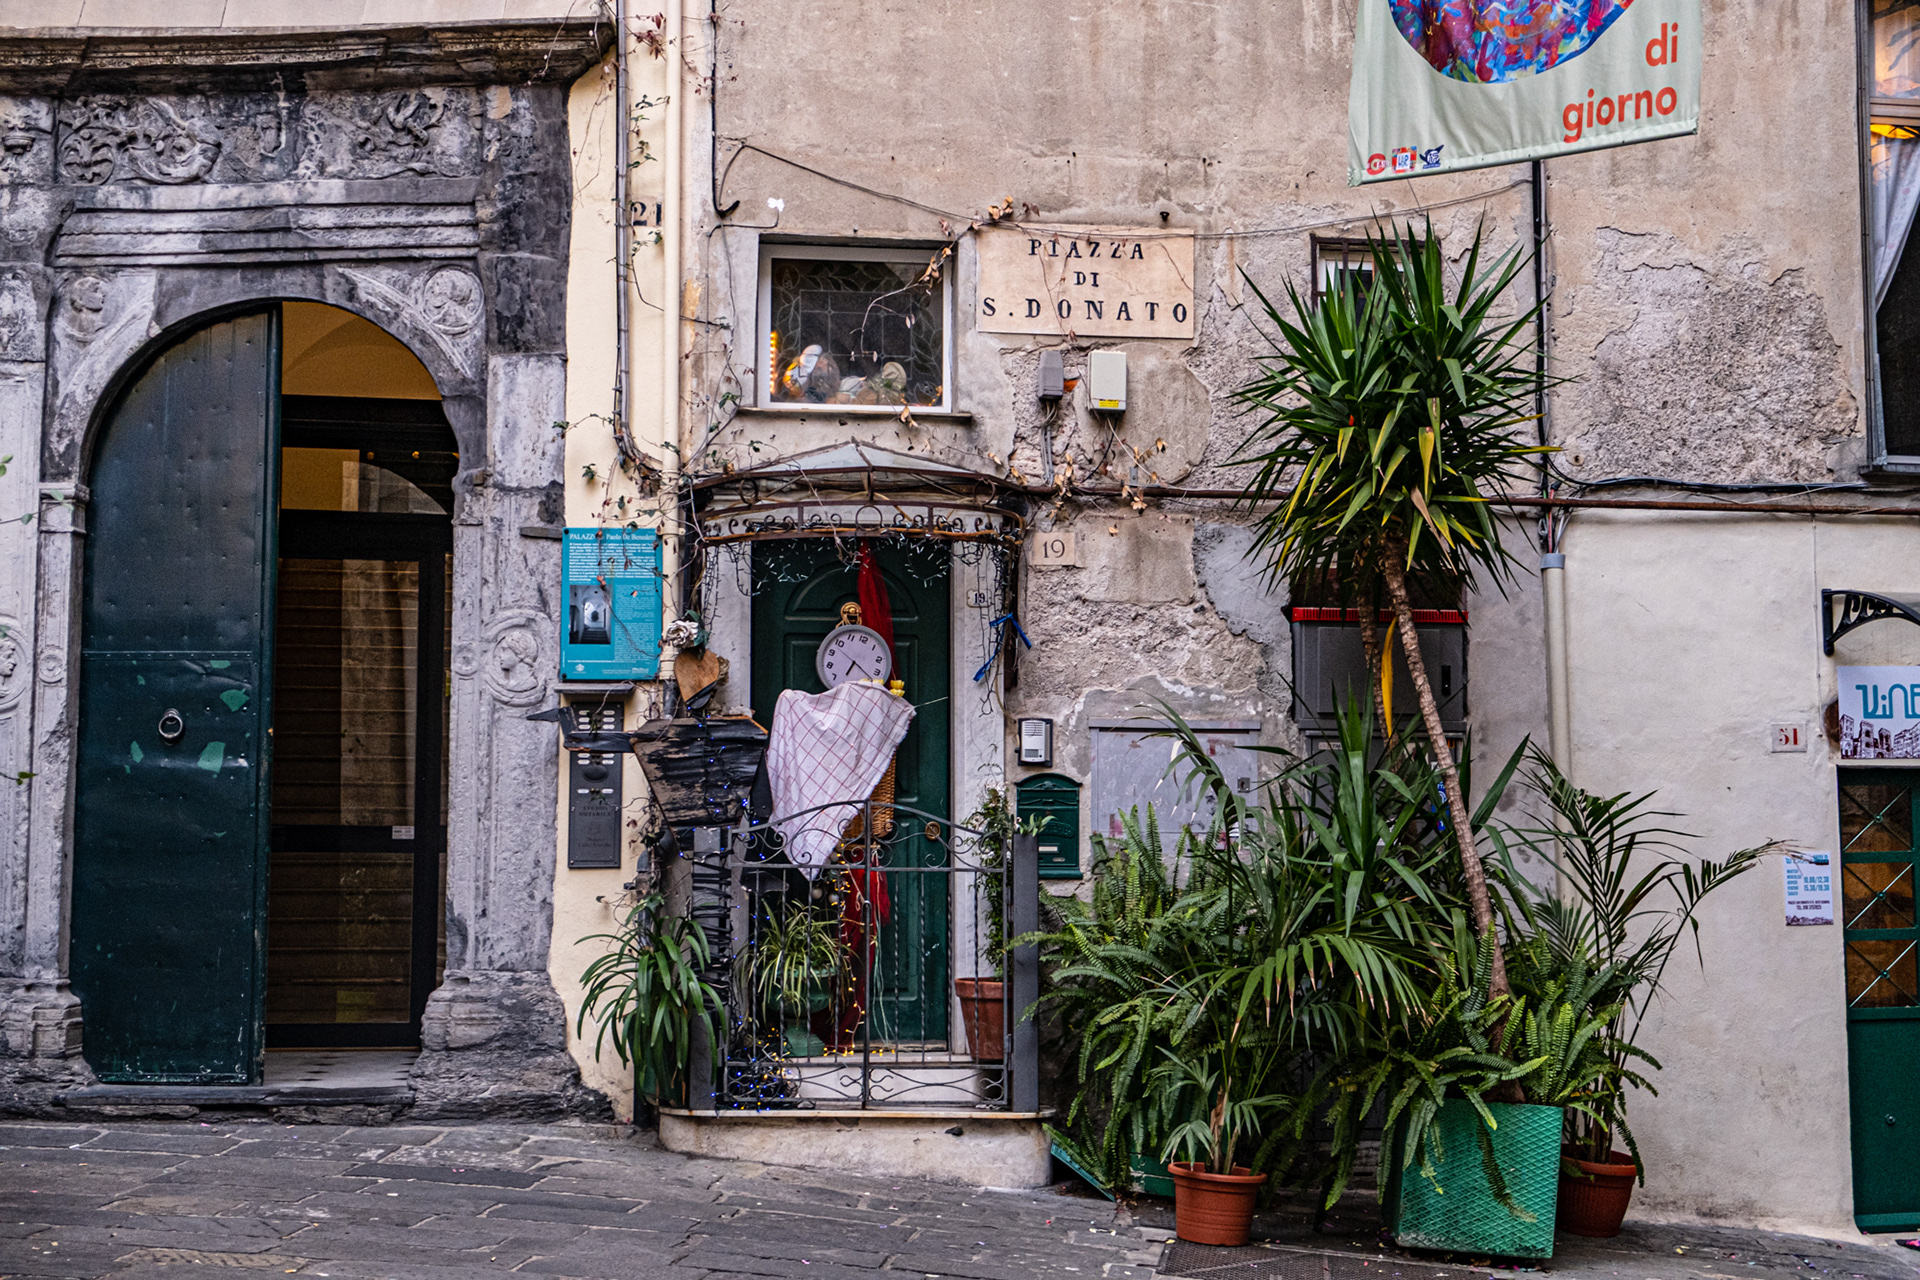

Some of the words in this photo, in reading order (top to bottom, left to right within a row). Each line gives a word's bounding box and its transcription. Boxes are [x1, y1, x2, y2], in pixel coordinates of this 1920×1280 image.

[1645, 22, 1678, 67] di
[1562, 86, 1678, 144] giorno
[630, 201, 662, 226] 21
[1028, 238, 1145, 260] PIAZZA
[1073, 271, 1100, 287] DI
[1042, 539, 1065, 559] 19
[974, 592, 986, 605] 19
[835, 639, 845, 648] 10
[847, 634, 855, 642] 11
[858, 635, 869, 644] 12
[828, 649, 836, 657] 9
[826, 661, 834, 669] 8
[875, 656, 883, 664] 2
[832, 673, 837, 681] 7
[873, 668, 881, 676] 3
[1779, 728, 1799, 746] 51
